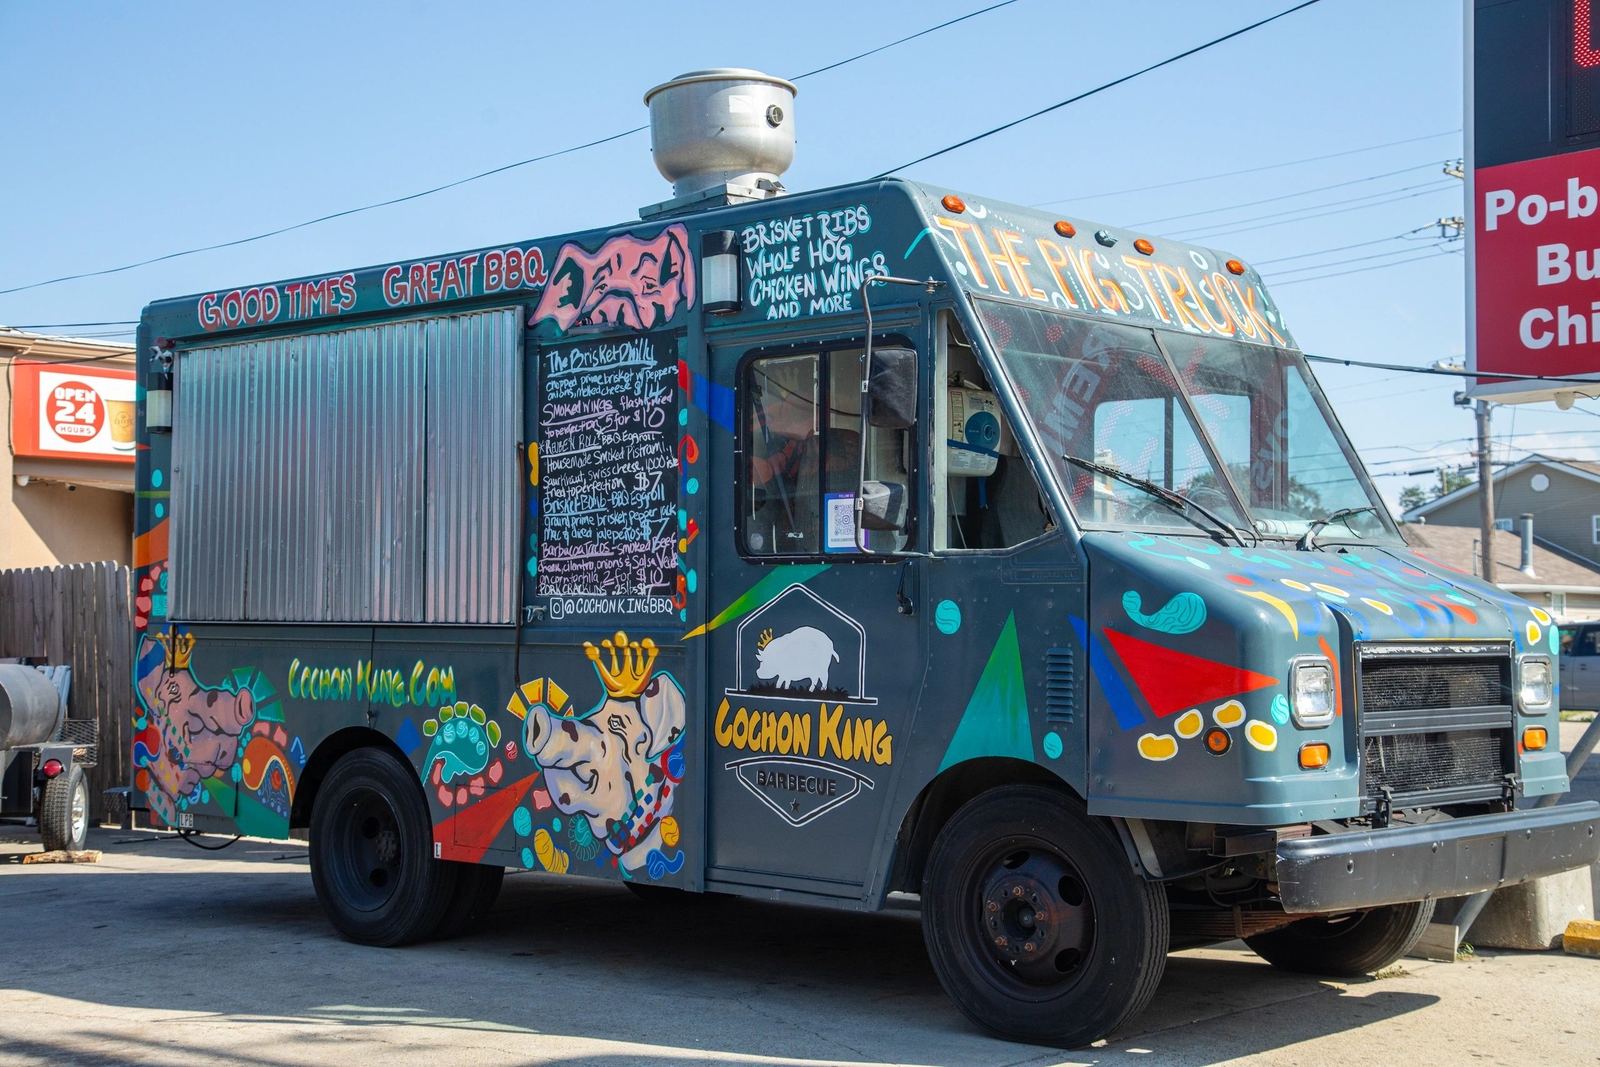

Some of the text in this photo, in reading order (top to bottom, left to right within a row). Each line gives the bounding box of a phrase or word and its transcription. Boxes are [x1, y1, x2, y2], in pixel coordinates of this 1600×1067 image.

[1485, 177, 1599, 231] Po-b
[818, 204, 872, 242] RIBS
[746, 236, 852, 280] WHOLE HOG
[198, 246, 548, 332] GOOD TIMES GREAT BBQ
[932, 214, 1287, 349] THE PIG TRUCK
[767, 293, 853, 320] AND MORE
[545, 350, 568, 373] The
[54, 387, 97, 402] OPEN
[54, 400, 97, 424] 24
[632, 406, 665, 428] $10
[60, 426, 92, 435] HOURS
[601, 432, 621, 446] BBQ
[636, 567, 664, 585] $10
[288, 657, 352, 702] COCHON
[714, 696, 893, 766] COCHON KING
[756, 770, 837, 796] BARBECUE
